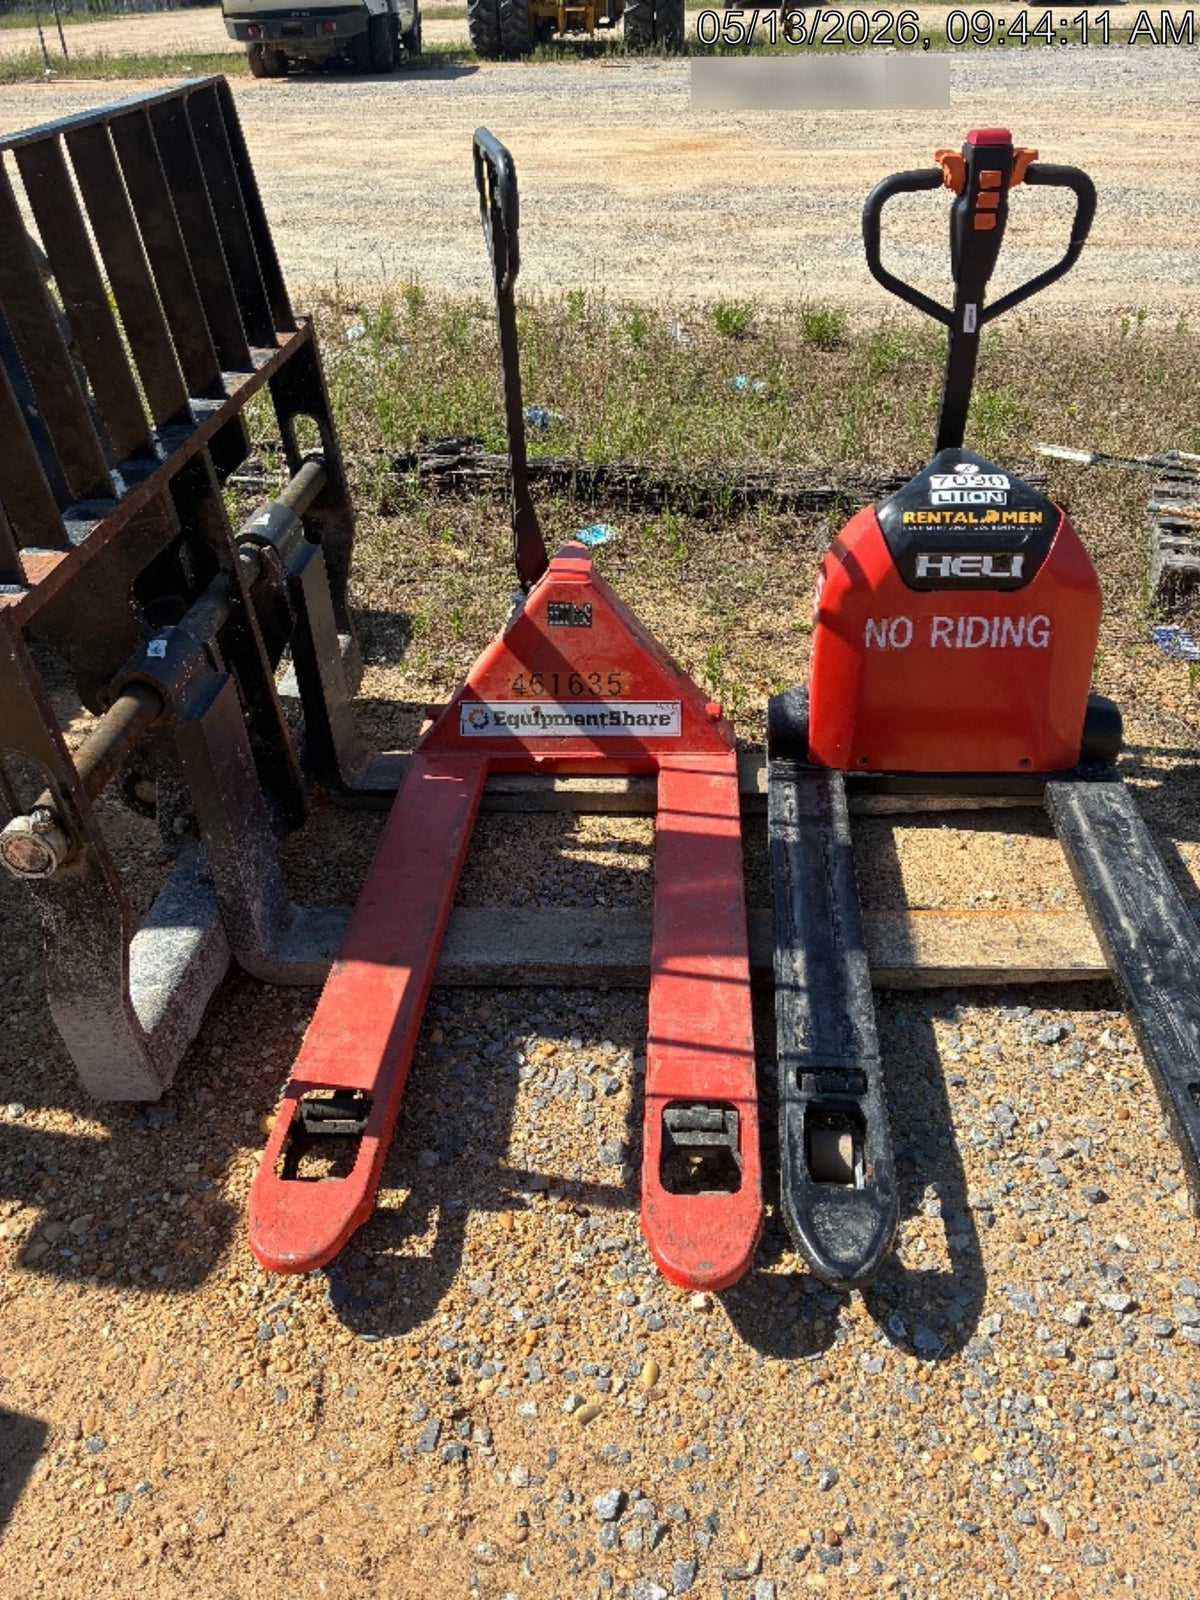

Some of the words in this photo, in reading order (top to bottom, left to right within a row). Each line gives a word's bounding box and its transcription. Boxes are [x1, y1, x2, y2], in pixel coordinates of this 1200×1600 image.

[902, 511, 978, 524] RENTAL
[1002, 511, 1043, 524] MEN
[915, 554, 1024, 578] HELI
[864, 616, 913, 649] NO
[931, 614, 1051, 649] RIDING
[511, 672, 623, 697] 461635
[494, 707, 671, 729] EquipmentShare
